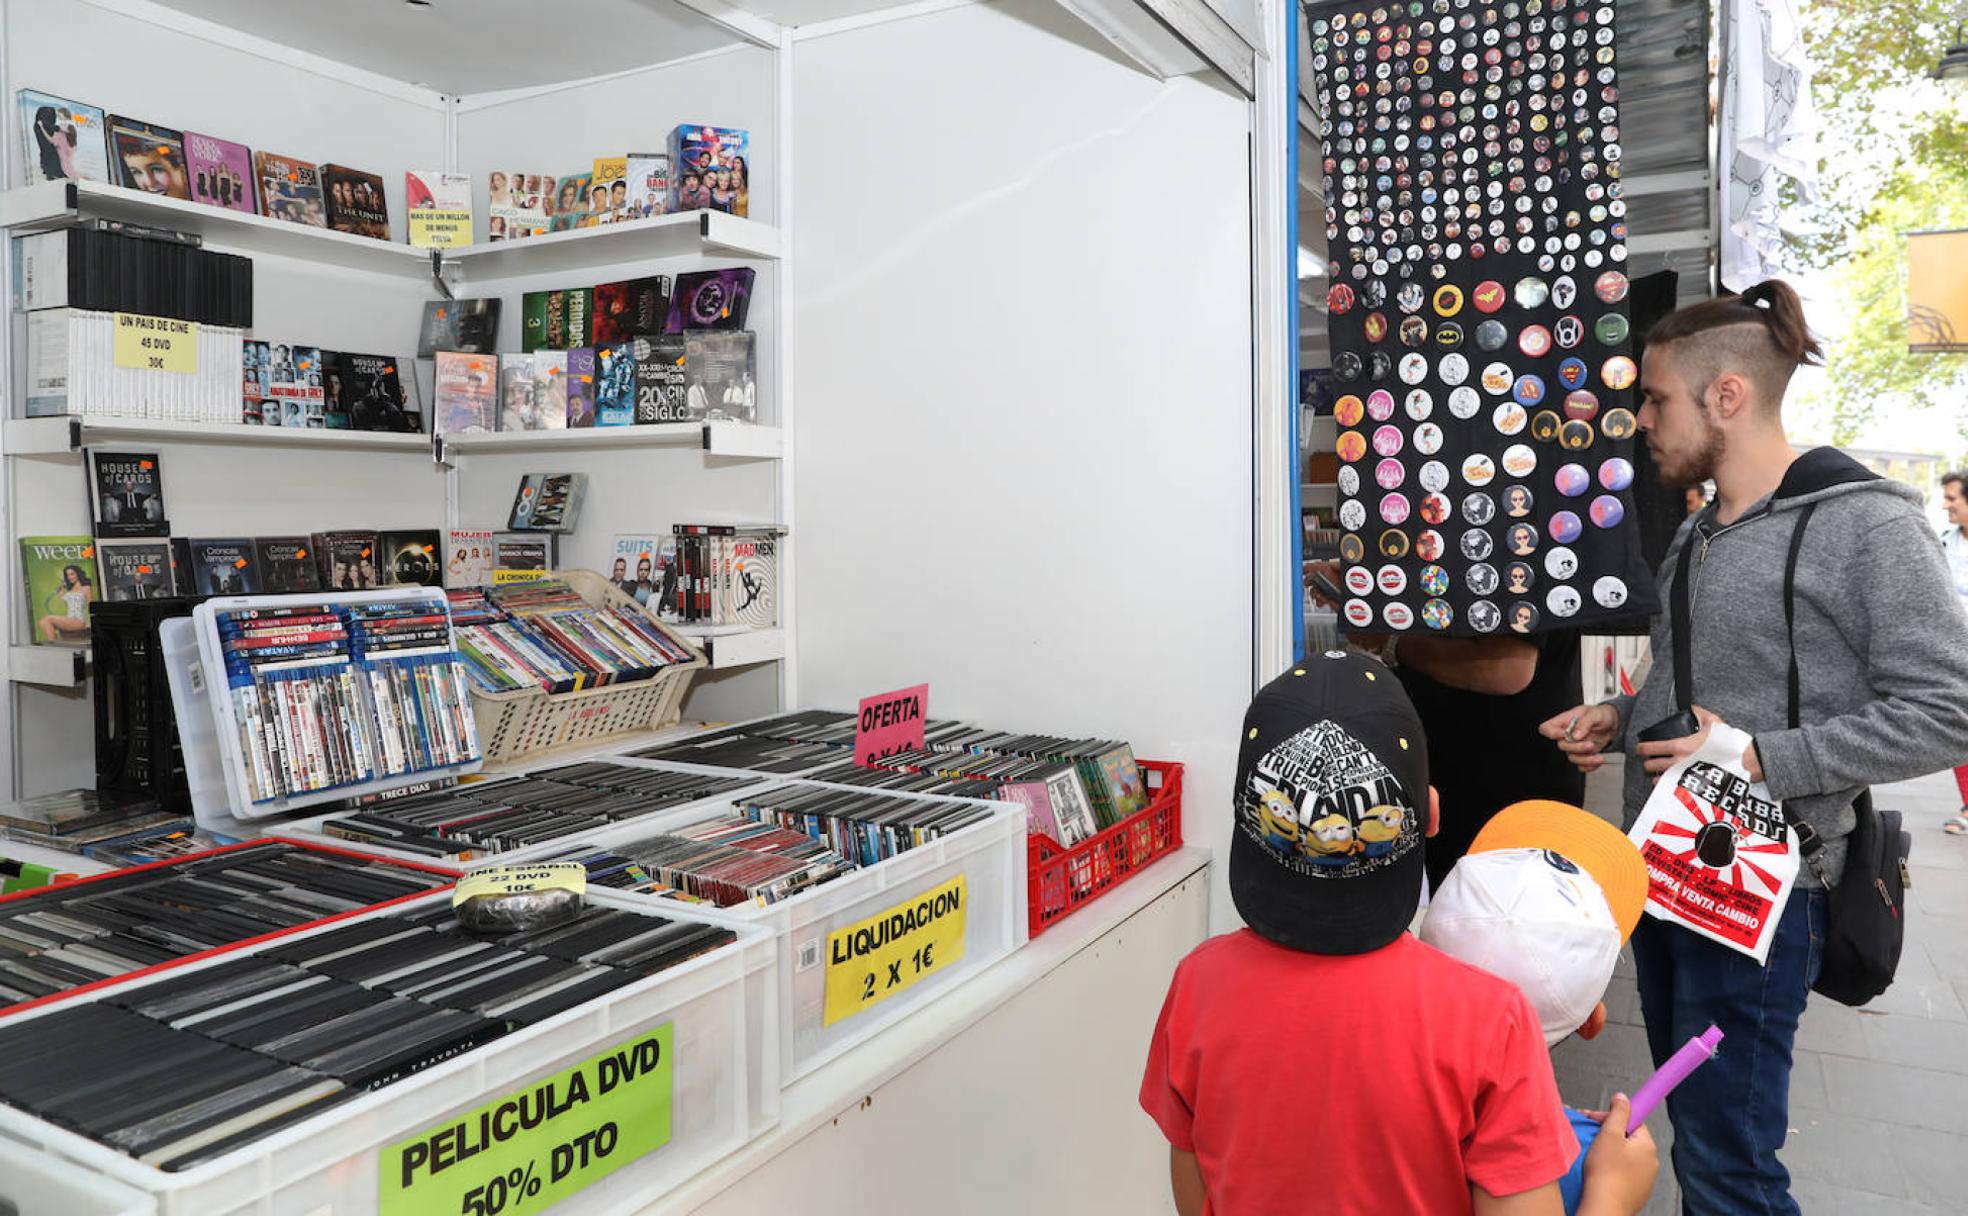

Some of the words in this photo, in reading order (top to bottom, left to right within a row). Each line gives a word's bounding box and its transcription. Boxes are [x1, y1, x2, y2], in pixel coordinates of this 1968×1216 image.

[120, 315, 133, 327] UN
[135, 317, 155, 330] PAIS
[157, 321, 169, 331] DE
[170, 322, 189, 334] CINE
[528, 318, 540, 328] 3
[568, 290, 584, 348] PERDIDOS
[141, 338, 152, 349] 45
[154, 338, 171, 350] DVD
[149, 357, 164, 369] 30€
[101, 462, 139, 474] HOUSE
[616, 540, 653, 553] SUITS
[862, 695, 919, 733] OFERTA
[1263, 752, 1305, 785] TRUE
[382, 787, 408, 800] TRECE
[410, 782, 431, 795] DIAS
[516, 872, 551, 881] DVD
[1647, 864, 1681, 892] OMPRA
[1682, 886, 1715, 911] VENTA
[1715, 903, 1760, 929] CAMBIO
[832, 886, 961, 966] LIQUIDACION
[862, 972, 875, 1002] 2
[886, 959, 902, 989] X
[912, 943, 934, 972] 1€
[411, 1041, 473, 1072] TRAVOLTA
[402, 1070, 590, 1190] PELICULA
[599, 1037, 661, 1095] DVD
[461, 1159, 541, 1216] 50%
[551, 1121, 619, 1184] DTO
